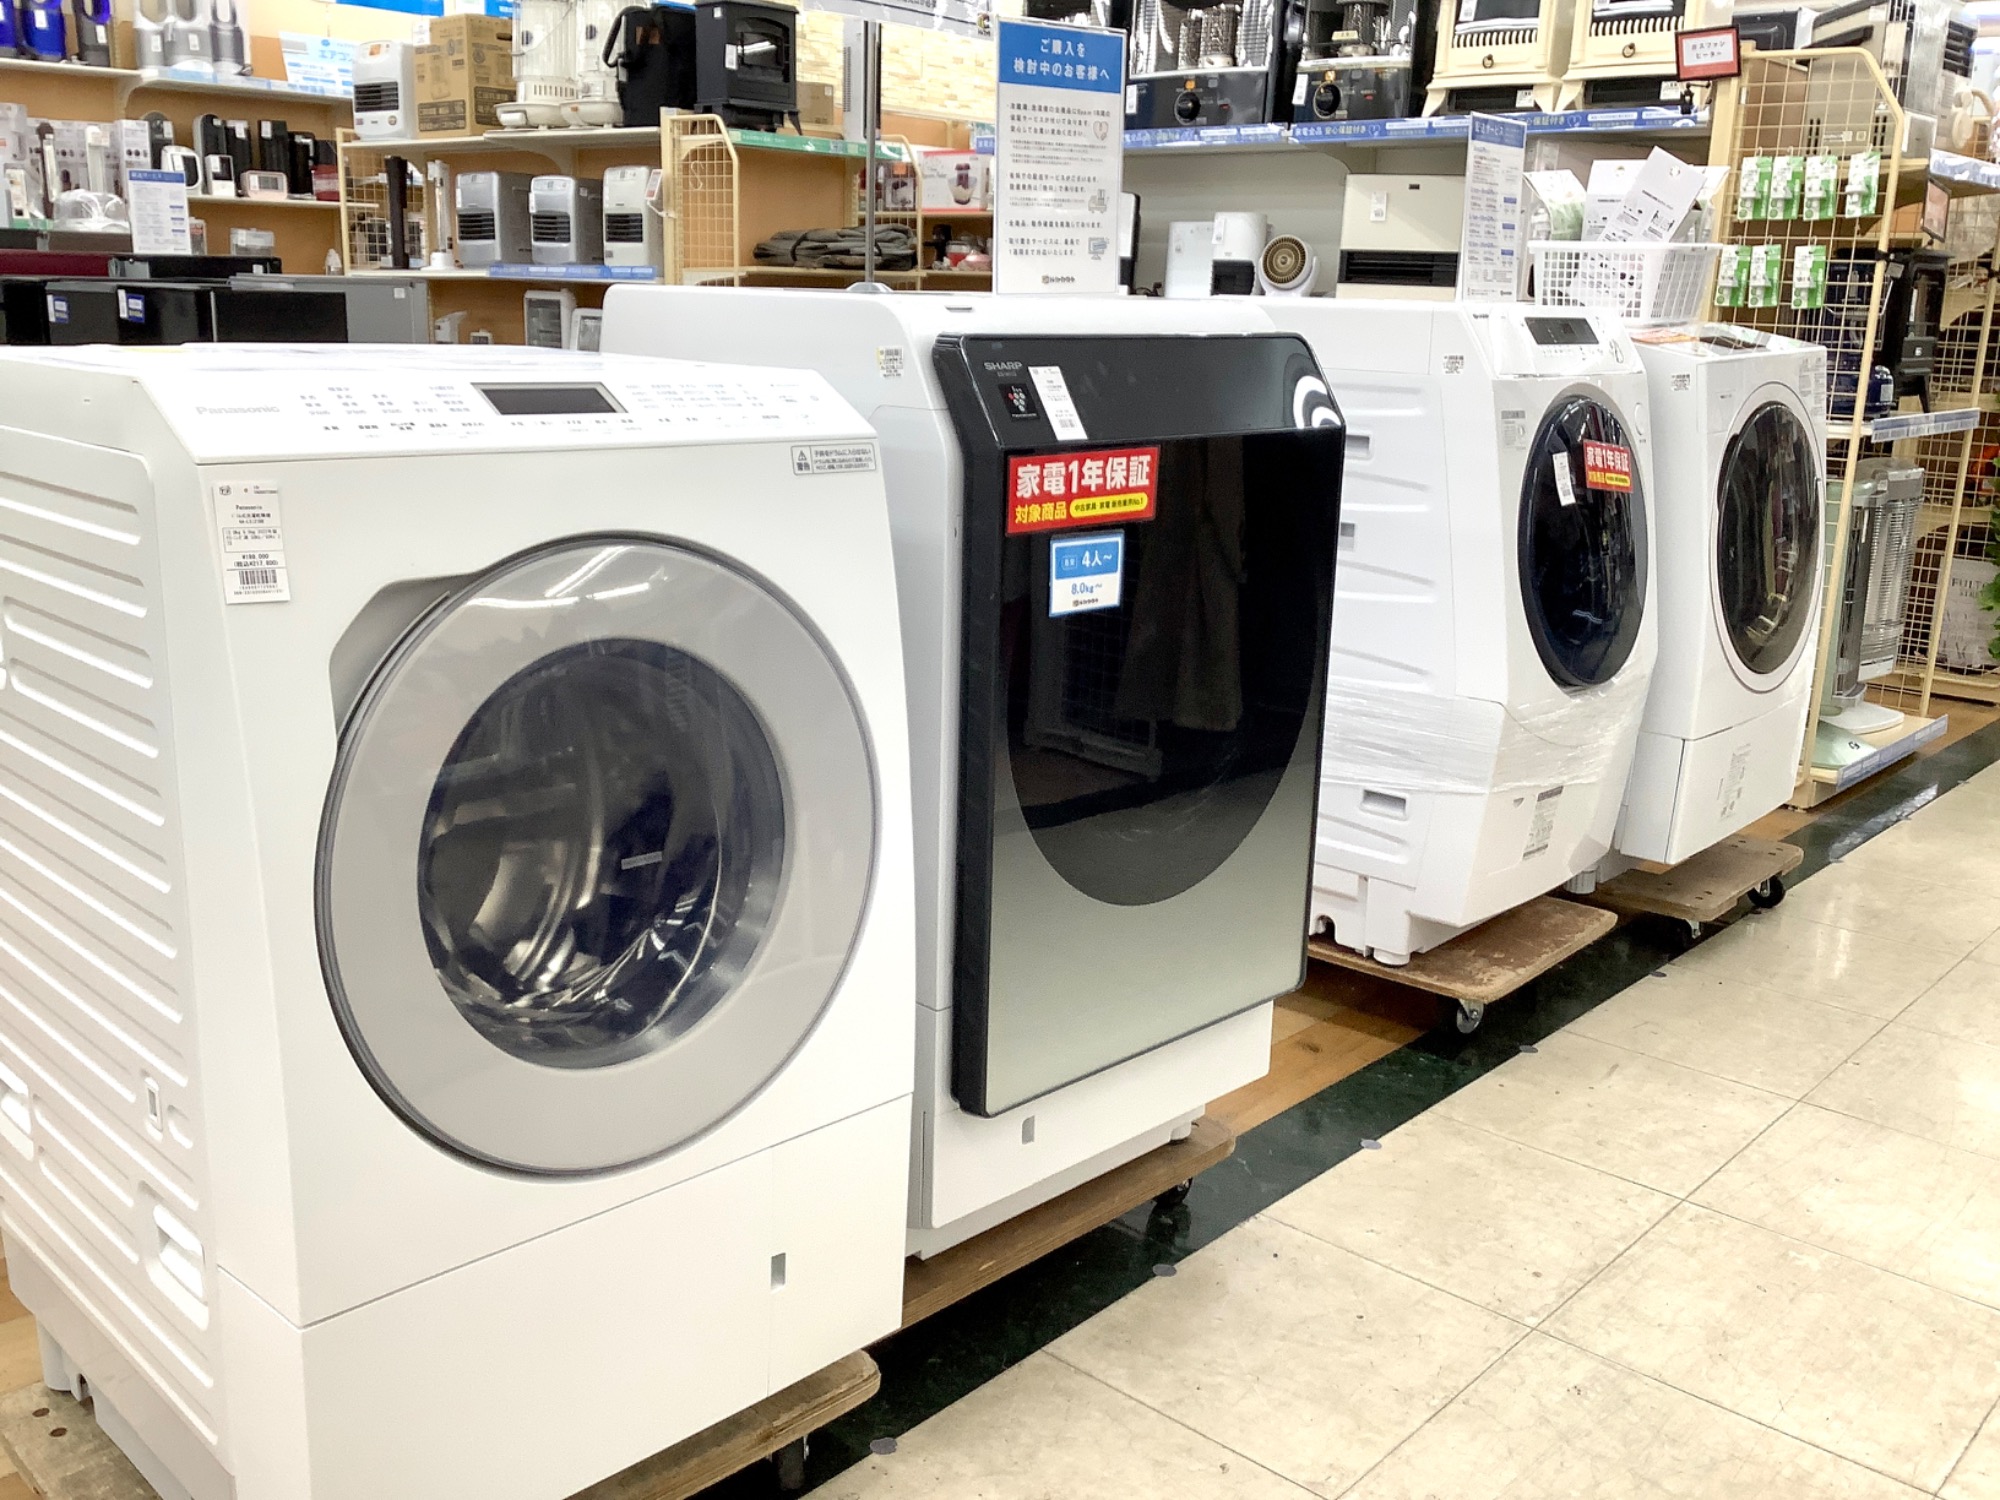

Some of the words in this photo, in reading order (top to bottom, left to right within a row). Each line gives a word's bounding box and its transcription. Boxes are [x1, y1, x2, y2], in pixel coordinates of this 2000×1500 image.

[1040, 38, 1085, 58] ご購入を
[1013, 57, 1110, 81] 検討中のお客様へ
[984, 361, 1022, 371] SHARP
[195, 406, 280, 415] Panasonic
[1015, 454, 1151, 499] 家電1年保証
[1015, 501, 1068, 524] 対象商品
